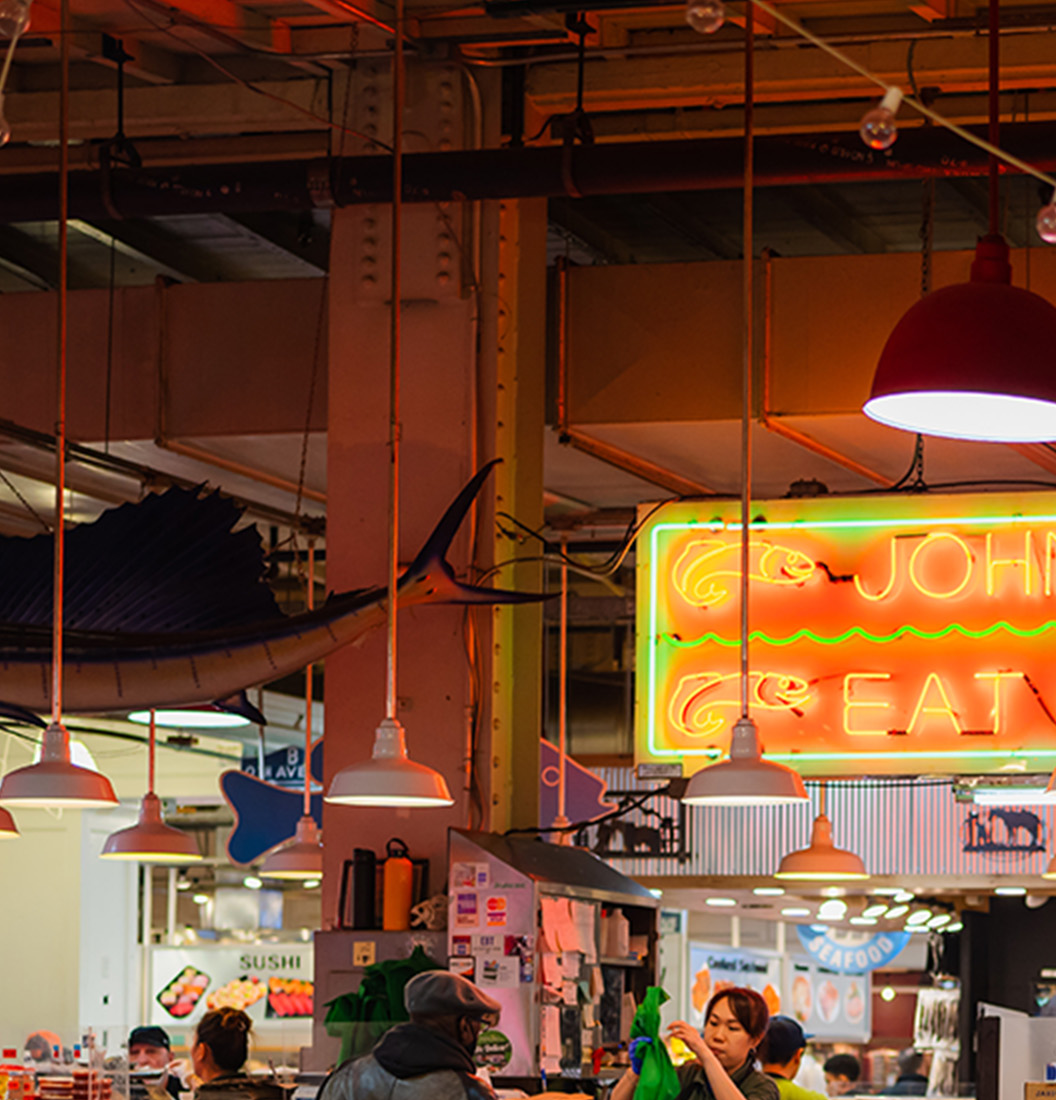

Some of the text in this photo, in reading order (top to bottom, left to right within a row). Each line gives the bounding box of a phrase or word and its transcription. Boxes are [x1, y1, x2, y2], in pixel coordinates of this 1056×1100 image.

[842, 671, 1026, 736] EAT
[287, 746, 299, 766] 8
[239, 953, 302, 971] SUSHI
[808, 936, 895, 969] SEAFOOD
